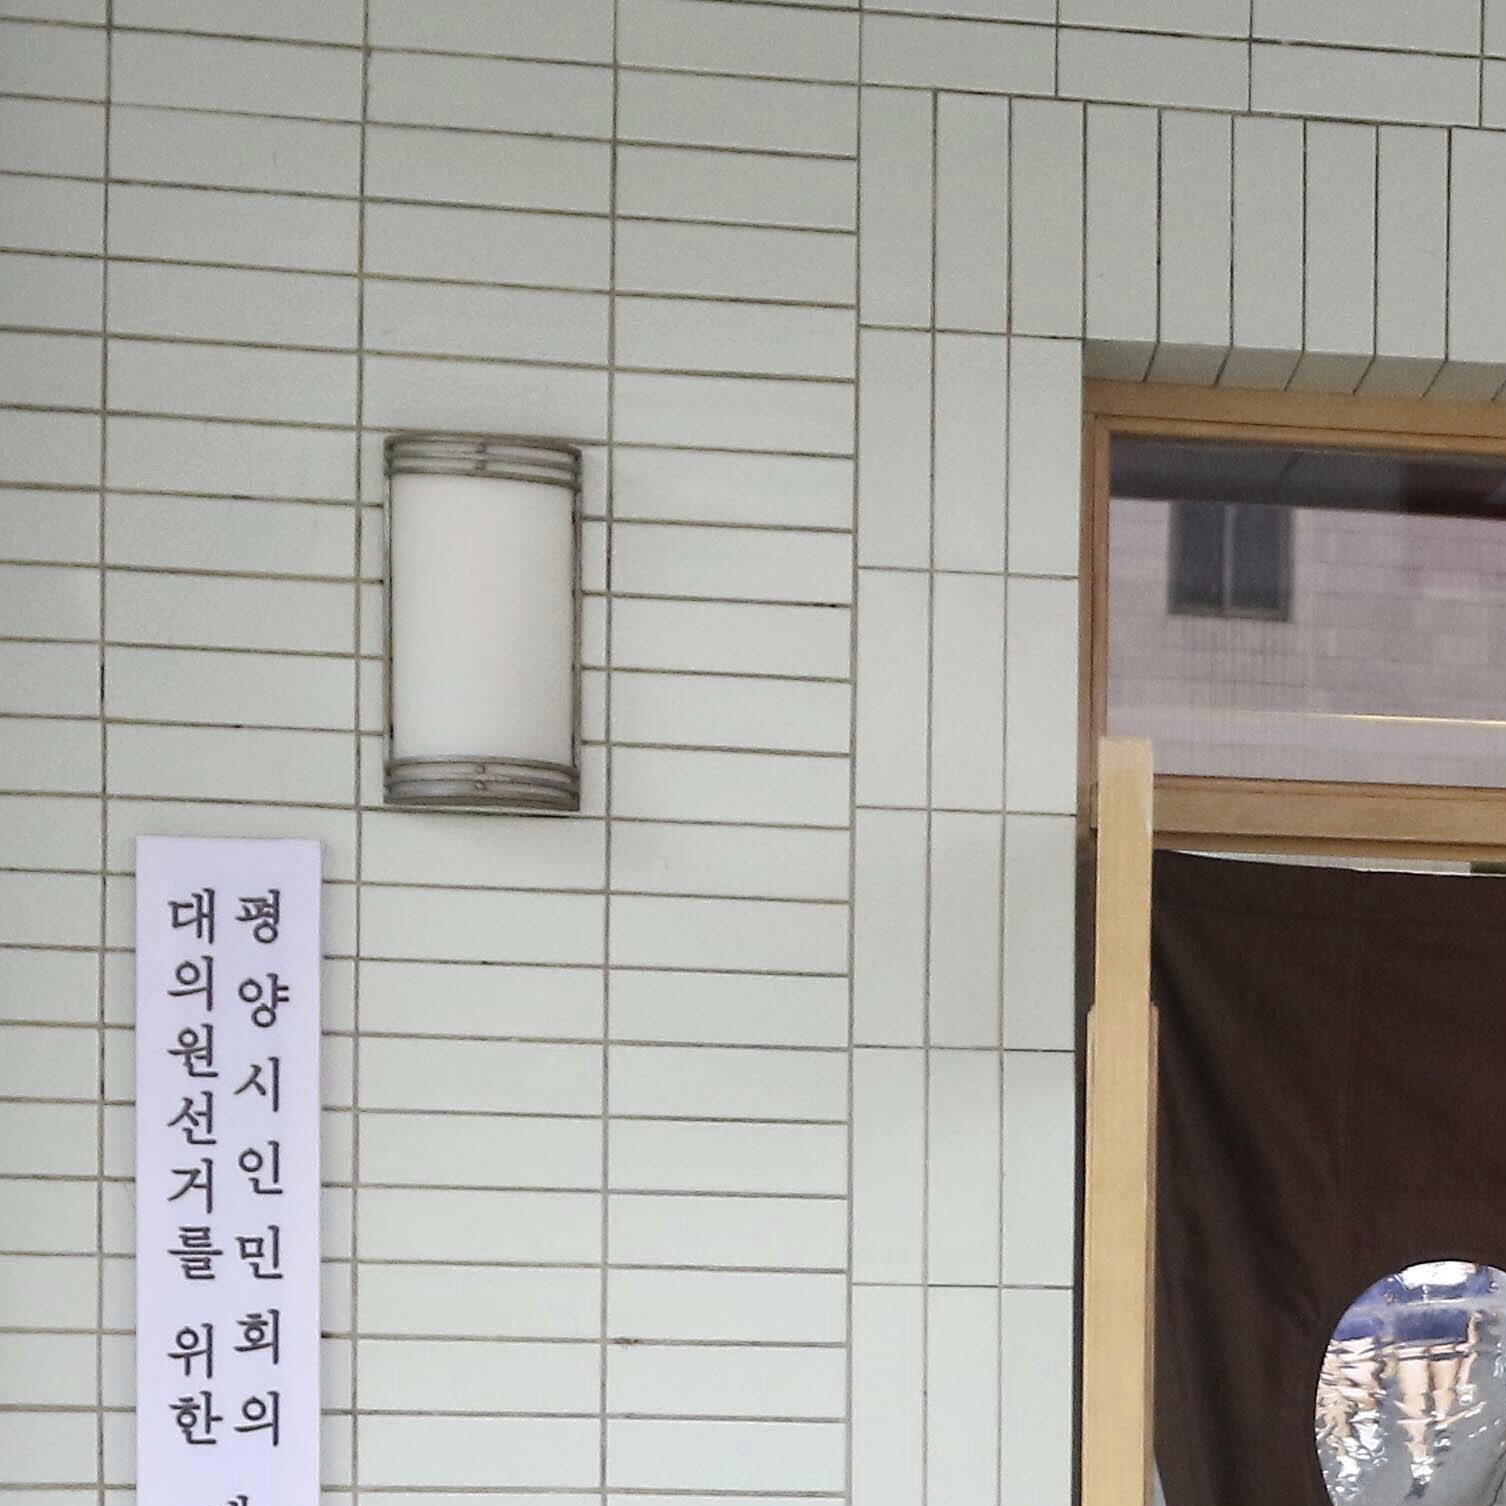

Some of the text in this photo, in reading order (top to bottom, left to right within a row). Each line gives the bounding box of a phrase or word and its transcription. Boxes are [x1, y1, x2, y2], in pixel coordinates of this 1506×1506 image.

[167, 887, 224, 1446] 대의원선거를 위한
[234, 888, 290, 1447] 평양시인민회의
